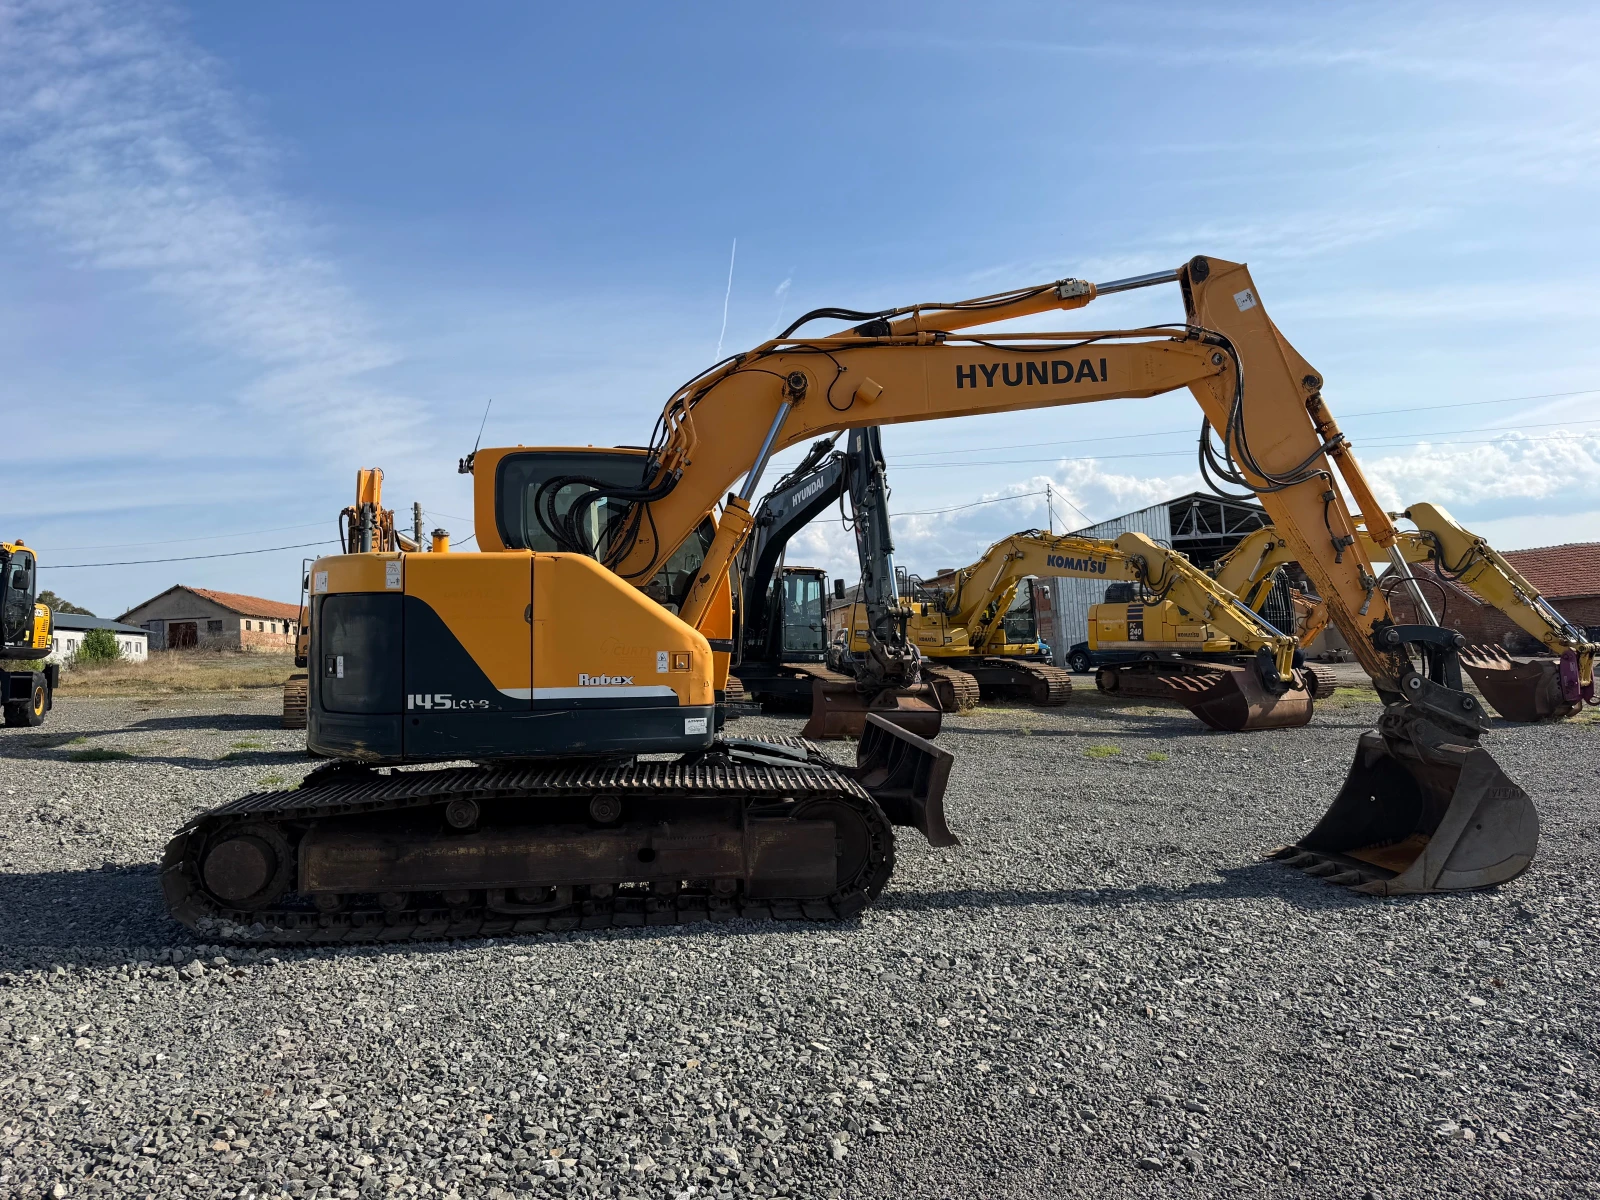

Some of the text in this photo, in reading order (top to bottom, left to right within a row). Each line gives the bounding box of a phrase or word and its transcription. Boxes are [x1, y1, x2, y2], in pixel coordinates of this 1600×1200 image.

[956, 358, 1108, 389] HYUNDAI
[792, 475, 824, 508] HYUNDAI
[1046, 554, 1107, 575] KOMATSU
[1129, 628, 1142, 636] 240
[578, 673, 635, 686] Robex
